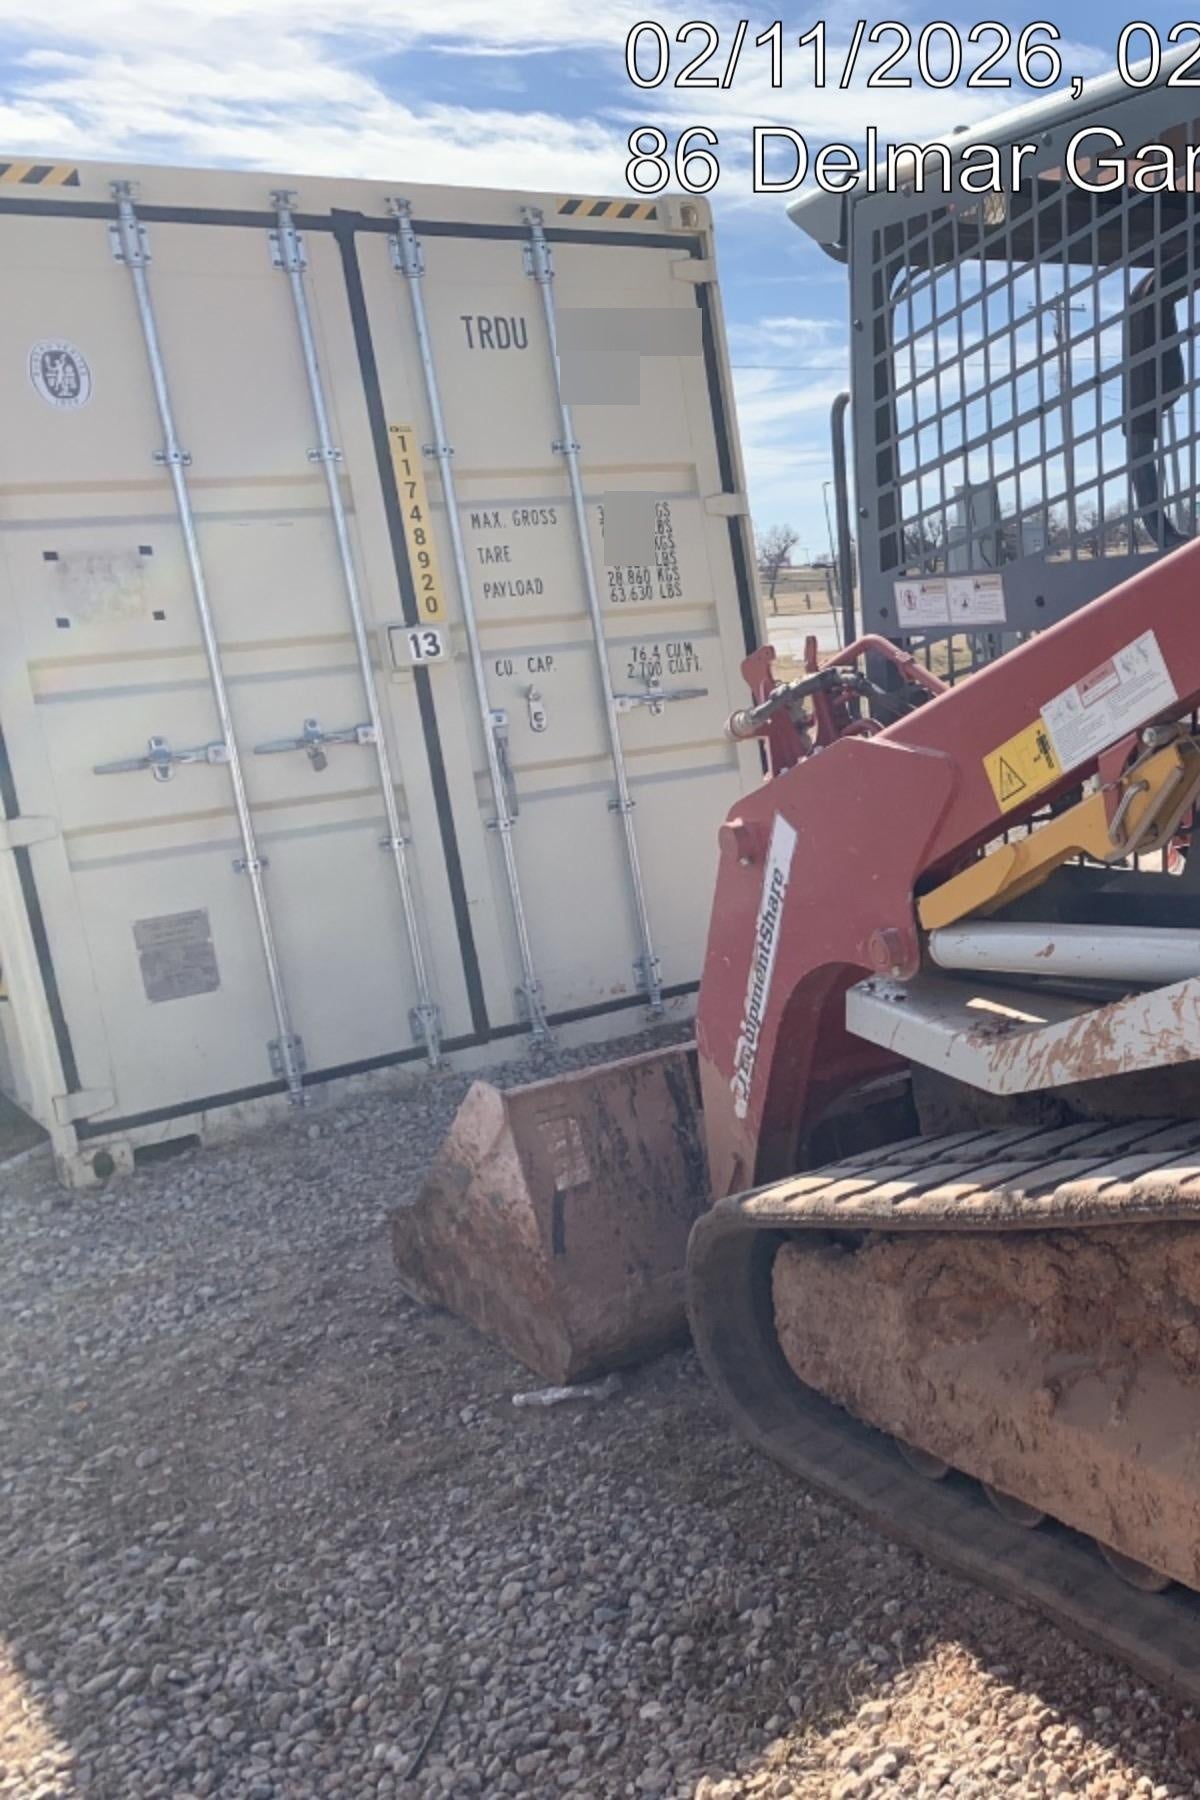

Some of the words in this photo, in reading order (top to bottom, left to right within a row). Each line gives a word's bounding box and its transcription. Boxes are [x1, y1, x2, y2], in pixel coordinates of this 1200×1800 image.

[460, 315, 529, 350] TRDU
[512, 508, 558, 526] GROSS
[477, 545, 512, 564] TARE
[483, 578, 544, 599] PAYLOAD
[409, 632, 441, 660] 13
